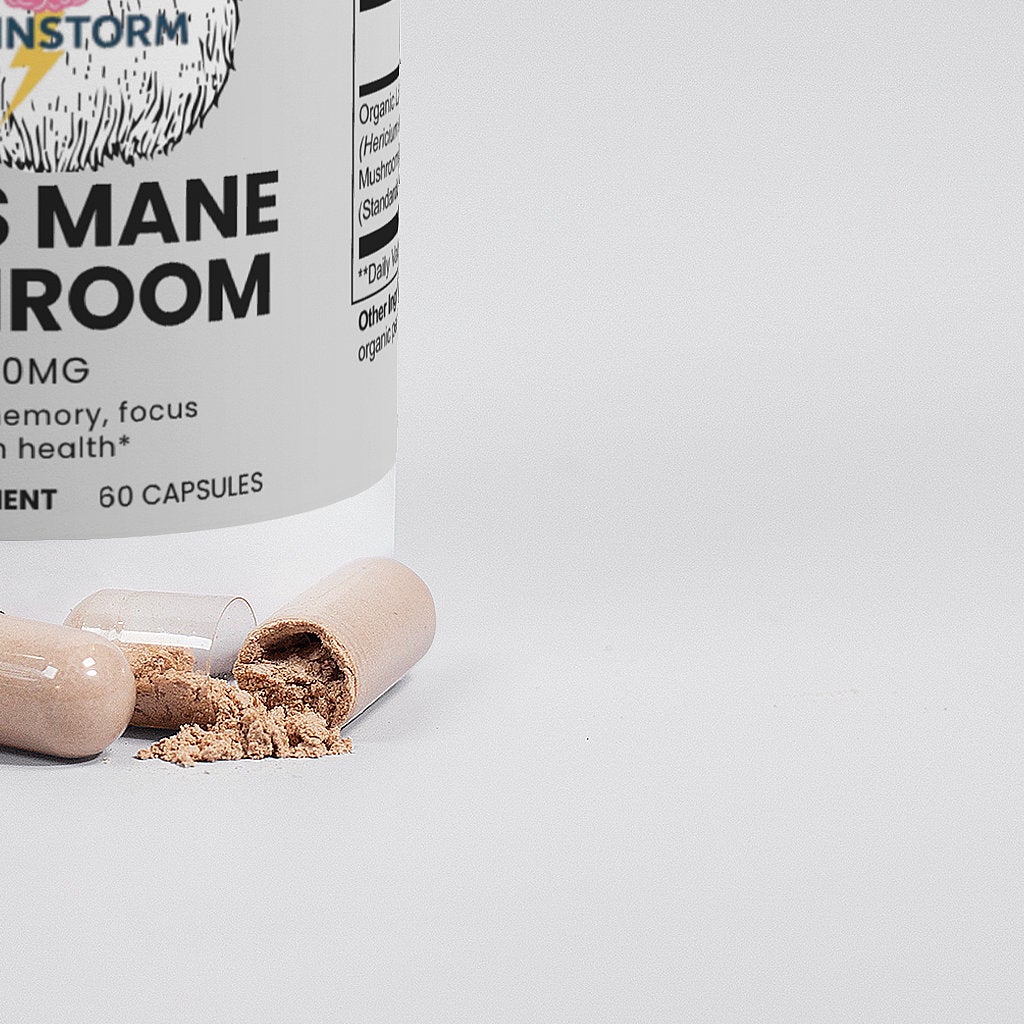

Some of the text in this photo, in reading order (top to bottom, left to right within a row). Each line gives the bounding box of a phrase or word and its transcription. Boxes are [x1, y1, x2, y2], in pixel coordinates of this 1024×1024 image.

[359, 92, 394, 125] Organic
[37, 170, 278, 249] MANE
[358, 302, 387, 331] Other
[358, 326, 391, 362] organic
[119, 400, 198, 423] focus
[99, 485, 133, 508] 60
[142, 471, 264, 505] CAPSULES
